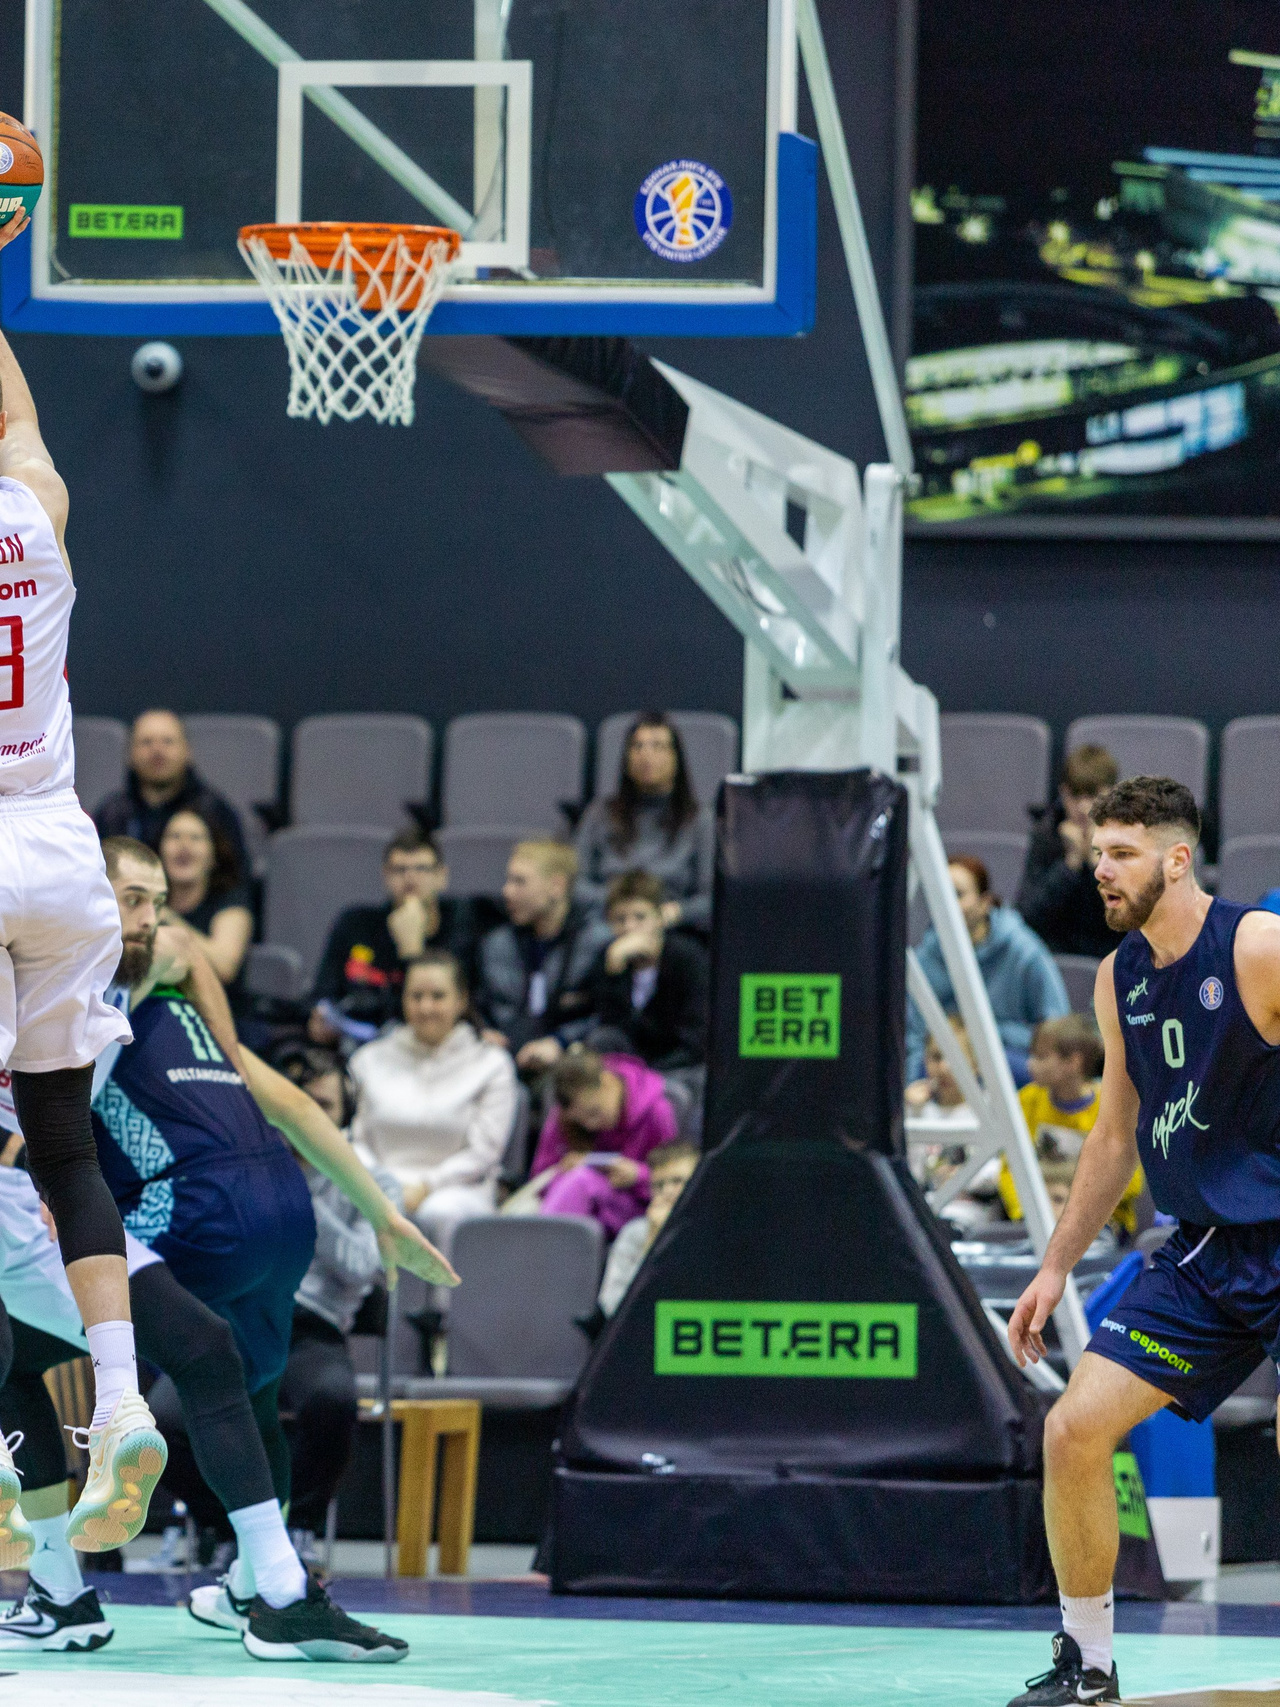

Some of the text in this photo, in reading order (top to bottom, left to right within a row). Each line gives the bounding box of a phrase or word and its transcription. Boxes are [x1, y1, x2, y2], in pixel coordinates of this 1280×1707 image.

[755, 986, 830, 1012] BET
[167, 1001, 224, 1063] 11
[1162, 1018, 1185, 1068] 0
[1129, 1329, 1193, 1374] евроопт
